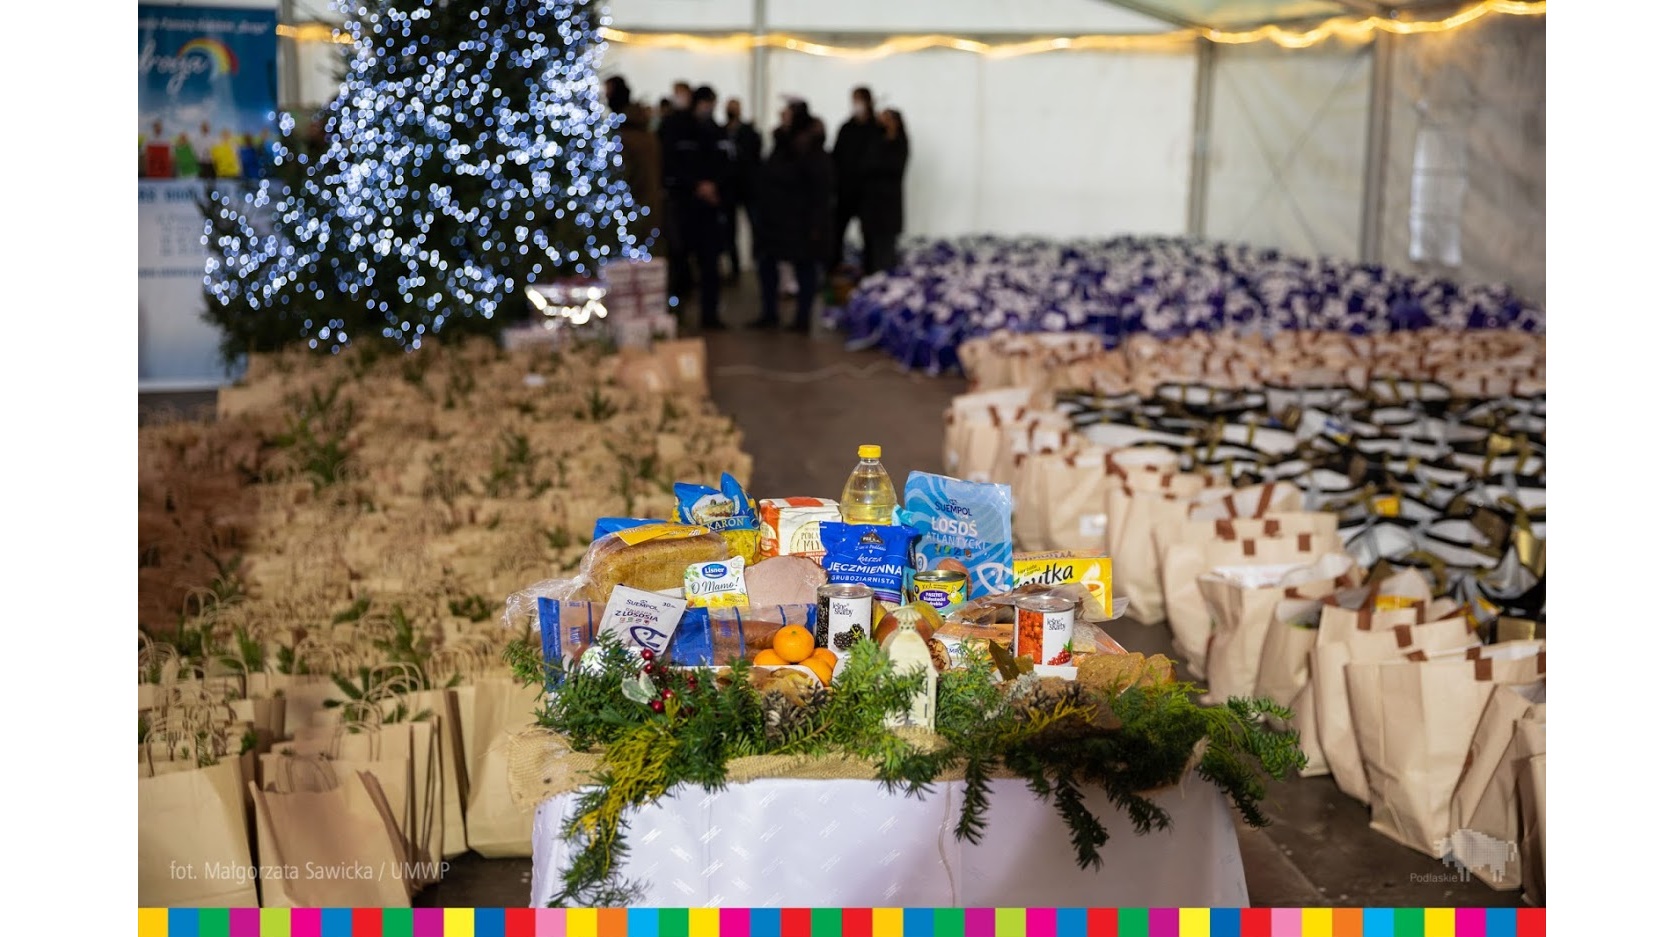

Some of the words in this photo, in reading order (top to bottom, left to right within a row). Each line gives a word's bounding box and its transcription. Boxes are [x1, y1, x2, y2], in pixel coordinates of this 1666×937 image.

[935, 501, 972, 516] SUEMPOL
[707, 517, 745, 531] KARON
[931, 516, 978, 537] ŁOSOŚ
[926, 531, 987, 550] ATLANTYCKI
[827, 562, 902, 576] JĘCZMIENNA
[831, 575, 895, 585] GRUBOZIARNISTA
[691, 582, 700, 594] O
[626, 599, 658, 611] SUEMPOL
